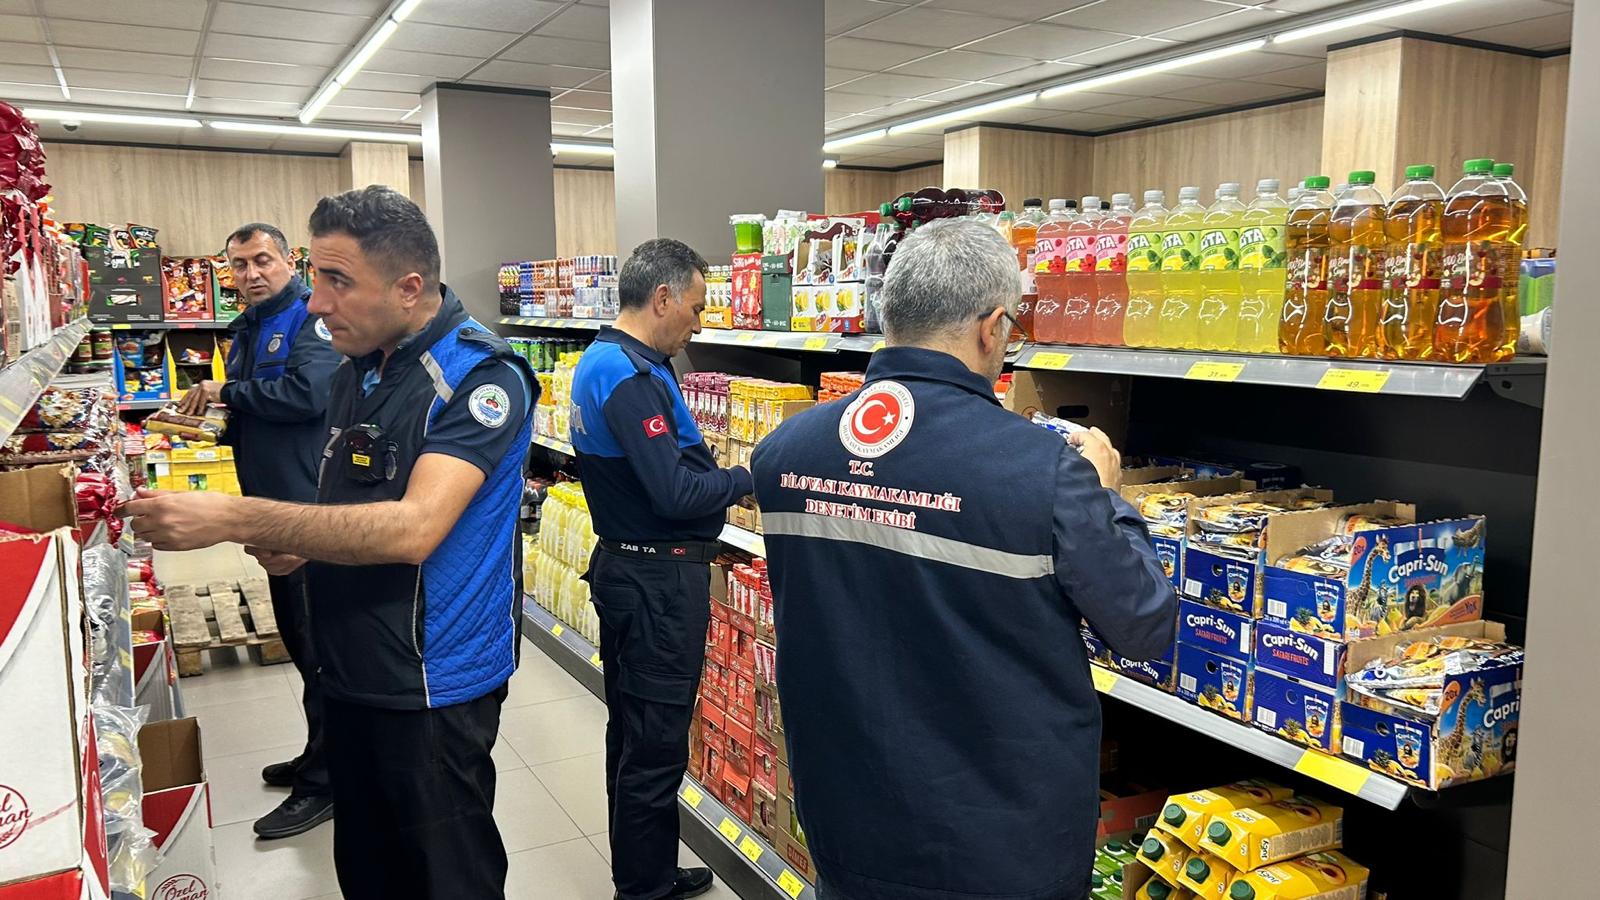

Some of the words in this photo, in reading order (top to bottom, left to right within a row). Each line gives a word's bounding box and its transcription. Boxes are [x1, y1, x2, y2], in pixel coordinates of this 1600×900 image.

[849, 460, 875, 477] T.C.
[780, 472, 837, 494] DİLOVASI
[837, 481, 962, 512] KAYMAKAMLIĞI
[805, 499, 871, 522] DENETİM
[871, 509, 916, 530] EKİBİ
[1388, 554, 1448, 584] Capri-Sun
[1187, 614, 1236, 640] Capri-Sun
[1262, 633, 1318, 660] Capri-Sun
